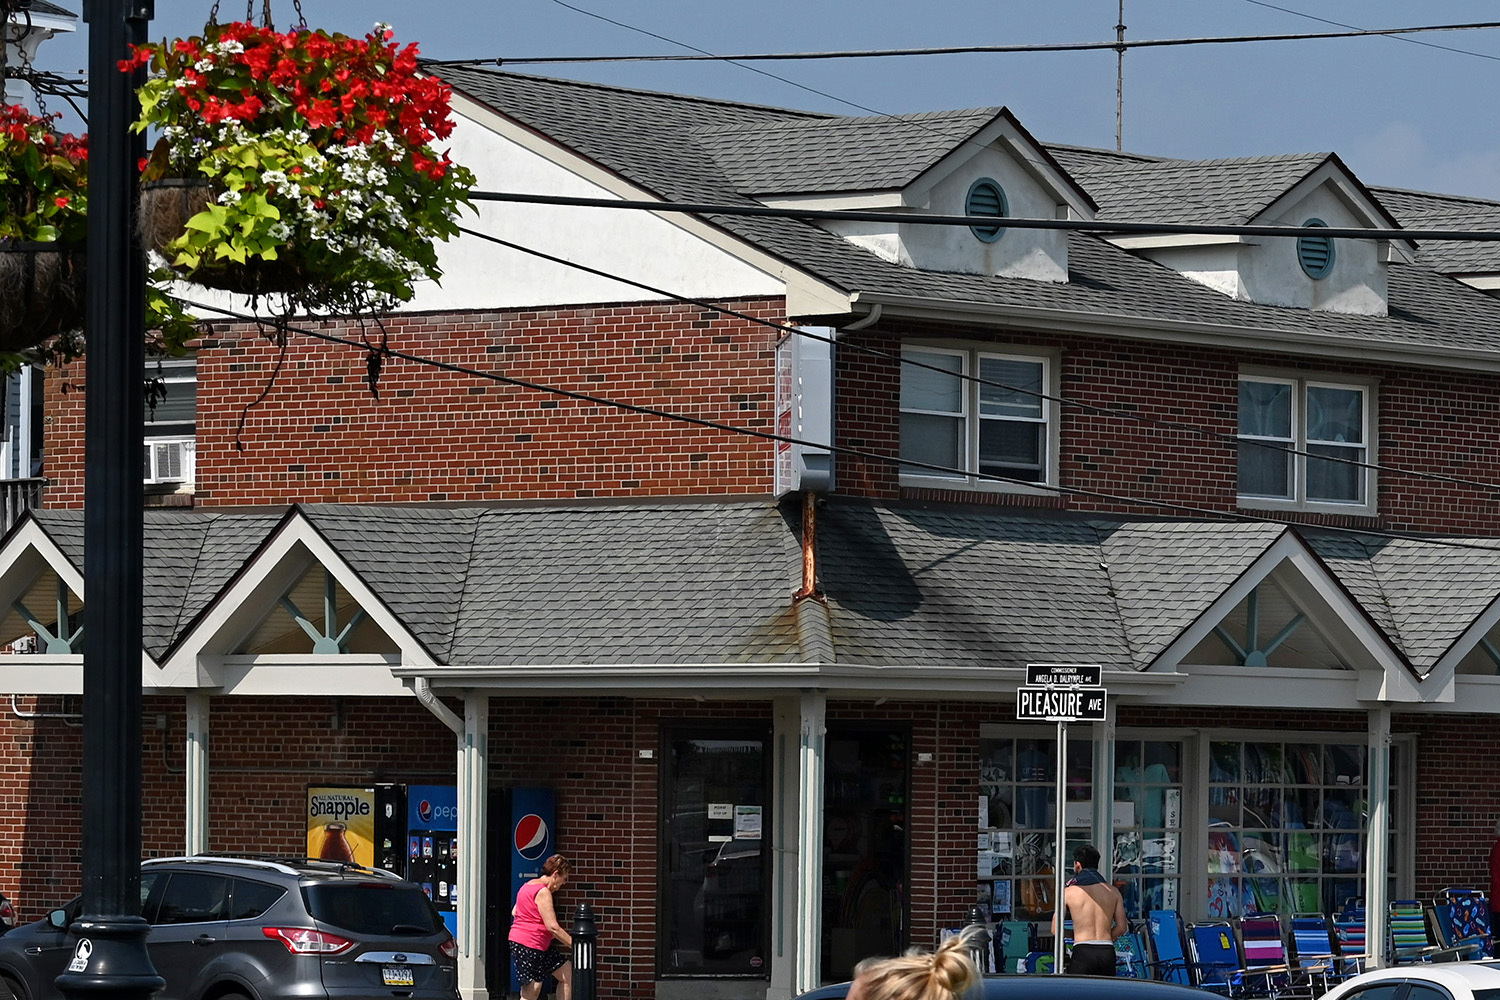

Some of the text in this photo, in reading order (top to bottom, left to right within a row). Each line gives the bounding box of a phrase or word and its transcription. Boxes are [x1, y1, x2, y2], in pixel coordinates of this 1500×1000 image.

[1035, 674, 1053, 683] ANGELA
[1059, 674, 1084, 684] DALRYMPLE
[1021, 692, 1102, 716] PLEASURE AVE
[310, 795, 370, 821] Snapple
